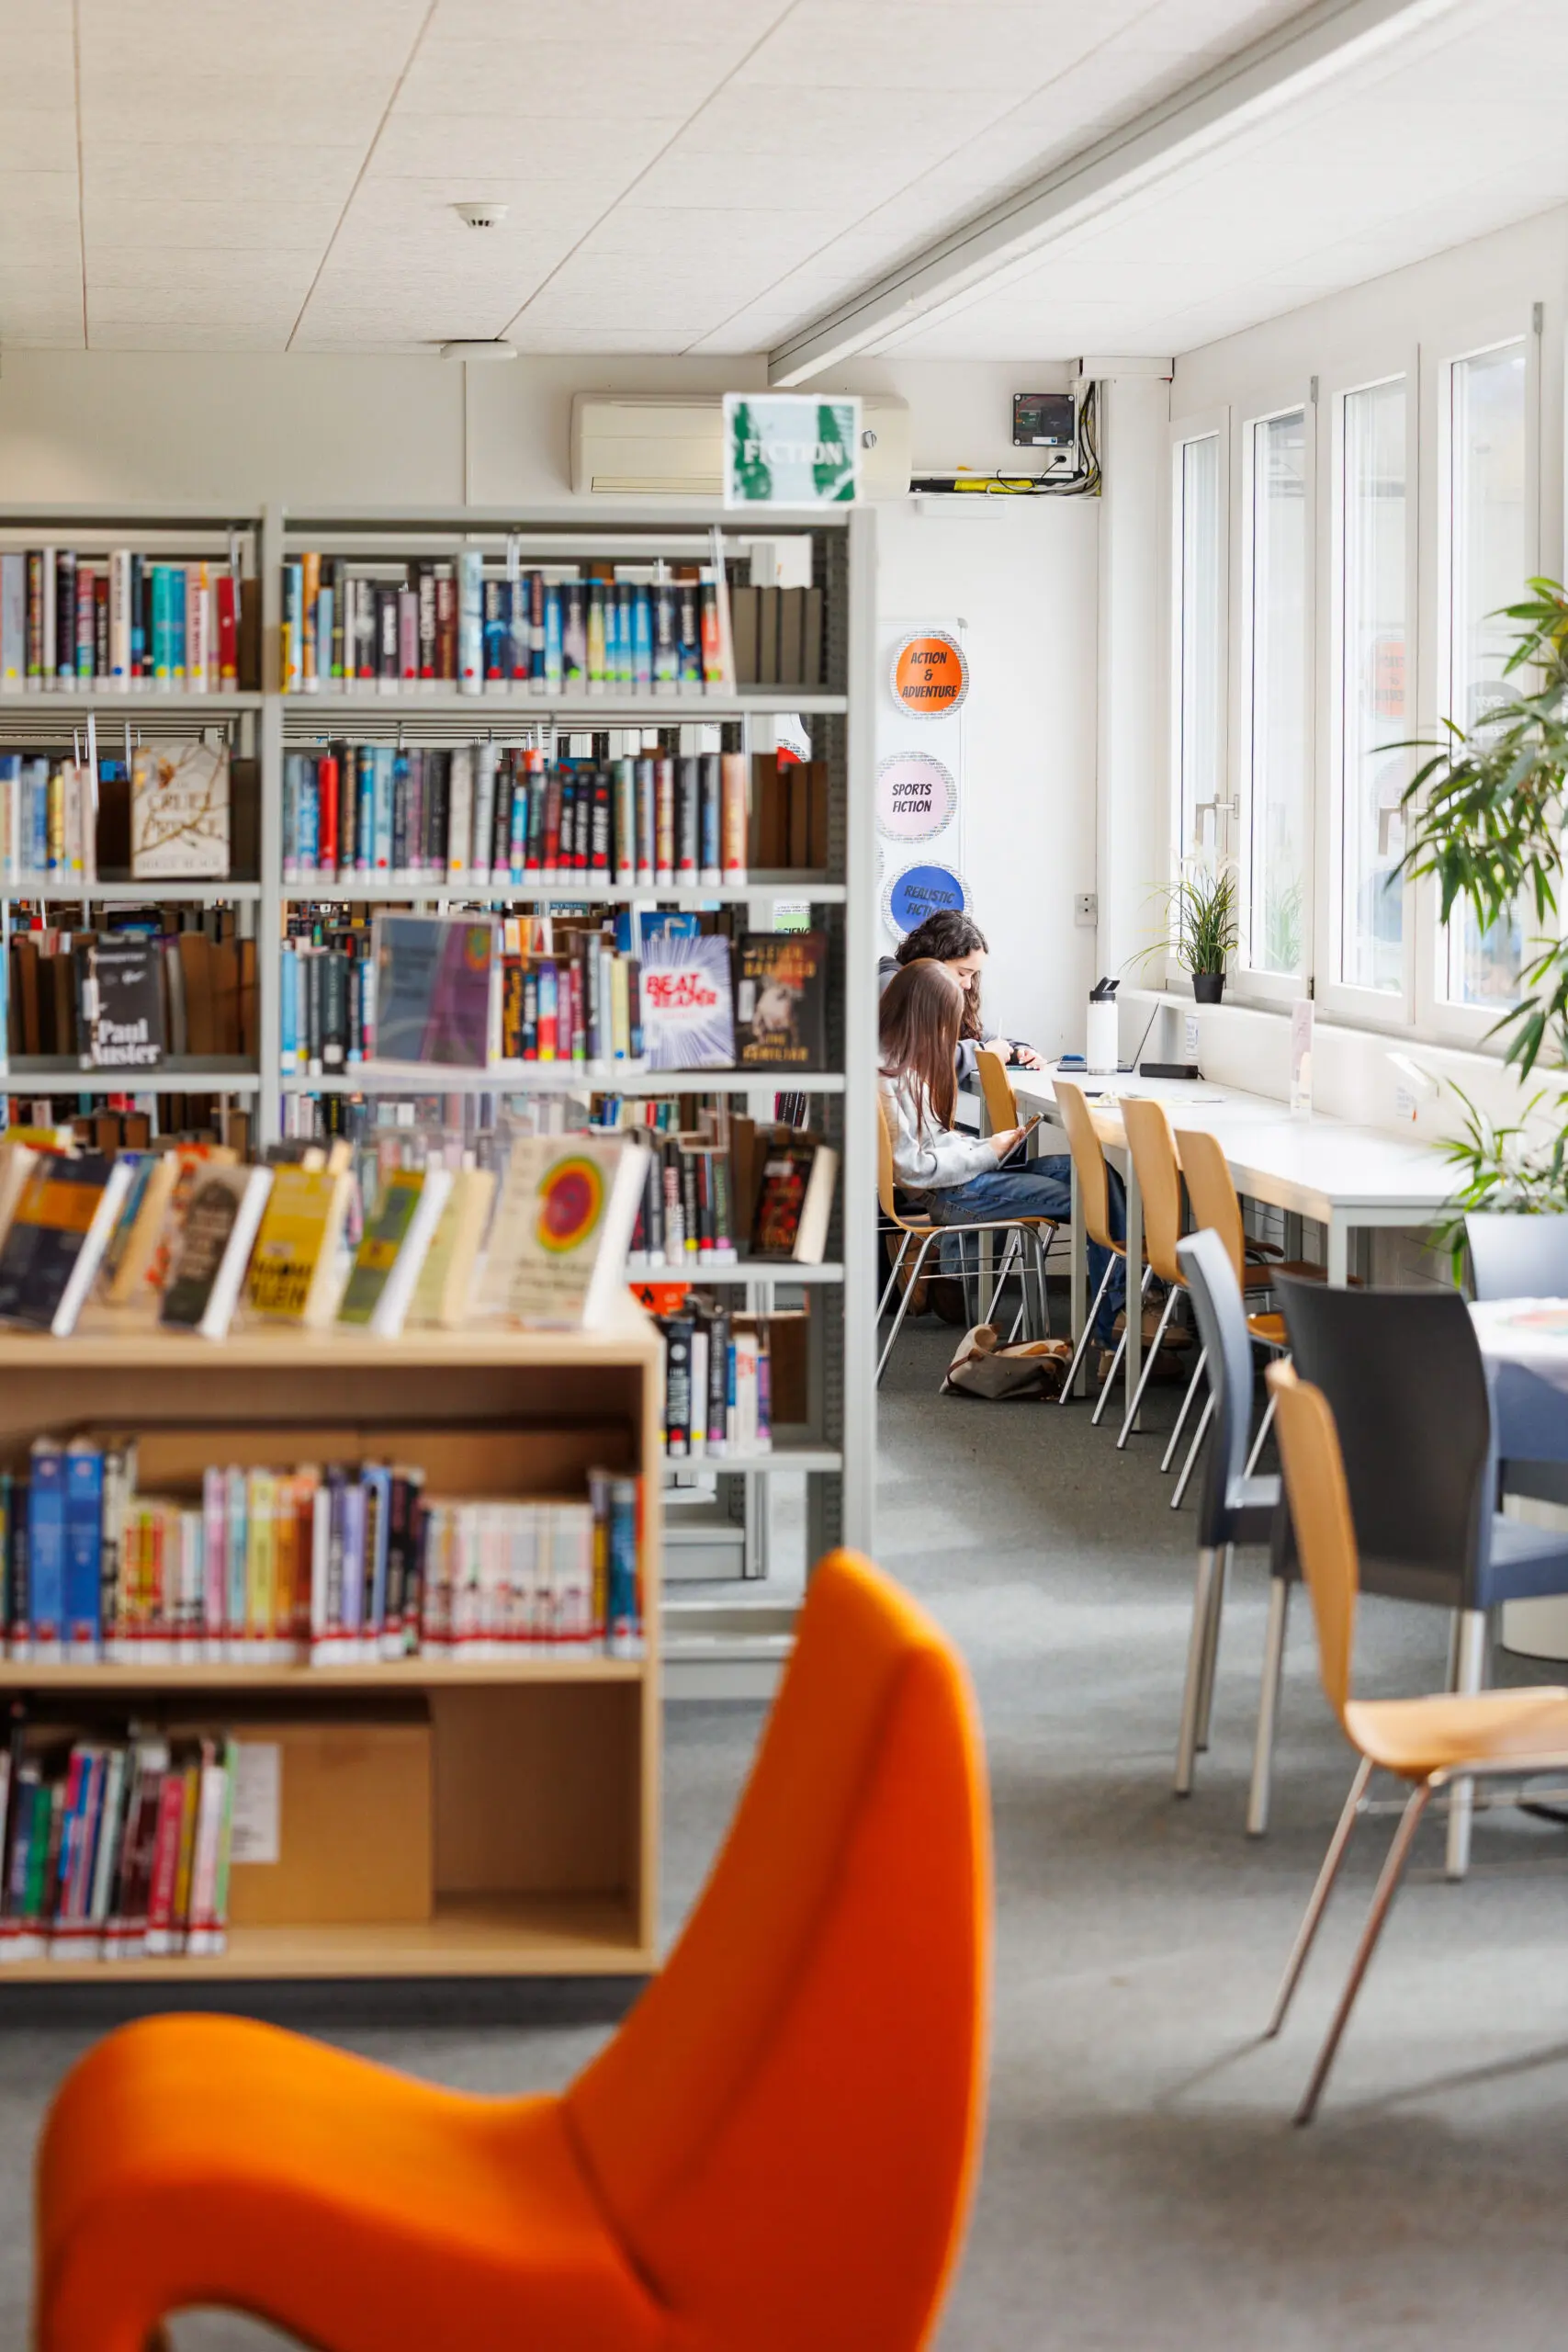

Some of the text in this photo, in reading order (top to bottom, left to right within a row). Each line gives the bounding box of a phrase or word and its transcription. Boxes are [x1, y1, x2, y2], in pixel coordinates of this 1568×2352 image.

[743, 439, 843, 465] FICTION
[910, 651, 948, 665] ACTION
[924, 669, 934, 682] &
[902, 684, 958, 698] ADVENTURE
[892, 783, 932, 796] SPORTS
[892, 800, 931, 813] FICTION
[905, 885, 955, 904] REALISTIC
[906, 901, 948, 918] FICTI
[647, 972, 698, 996] BEAT
[98, 1018, 149, 1045] Paul
